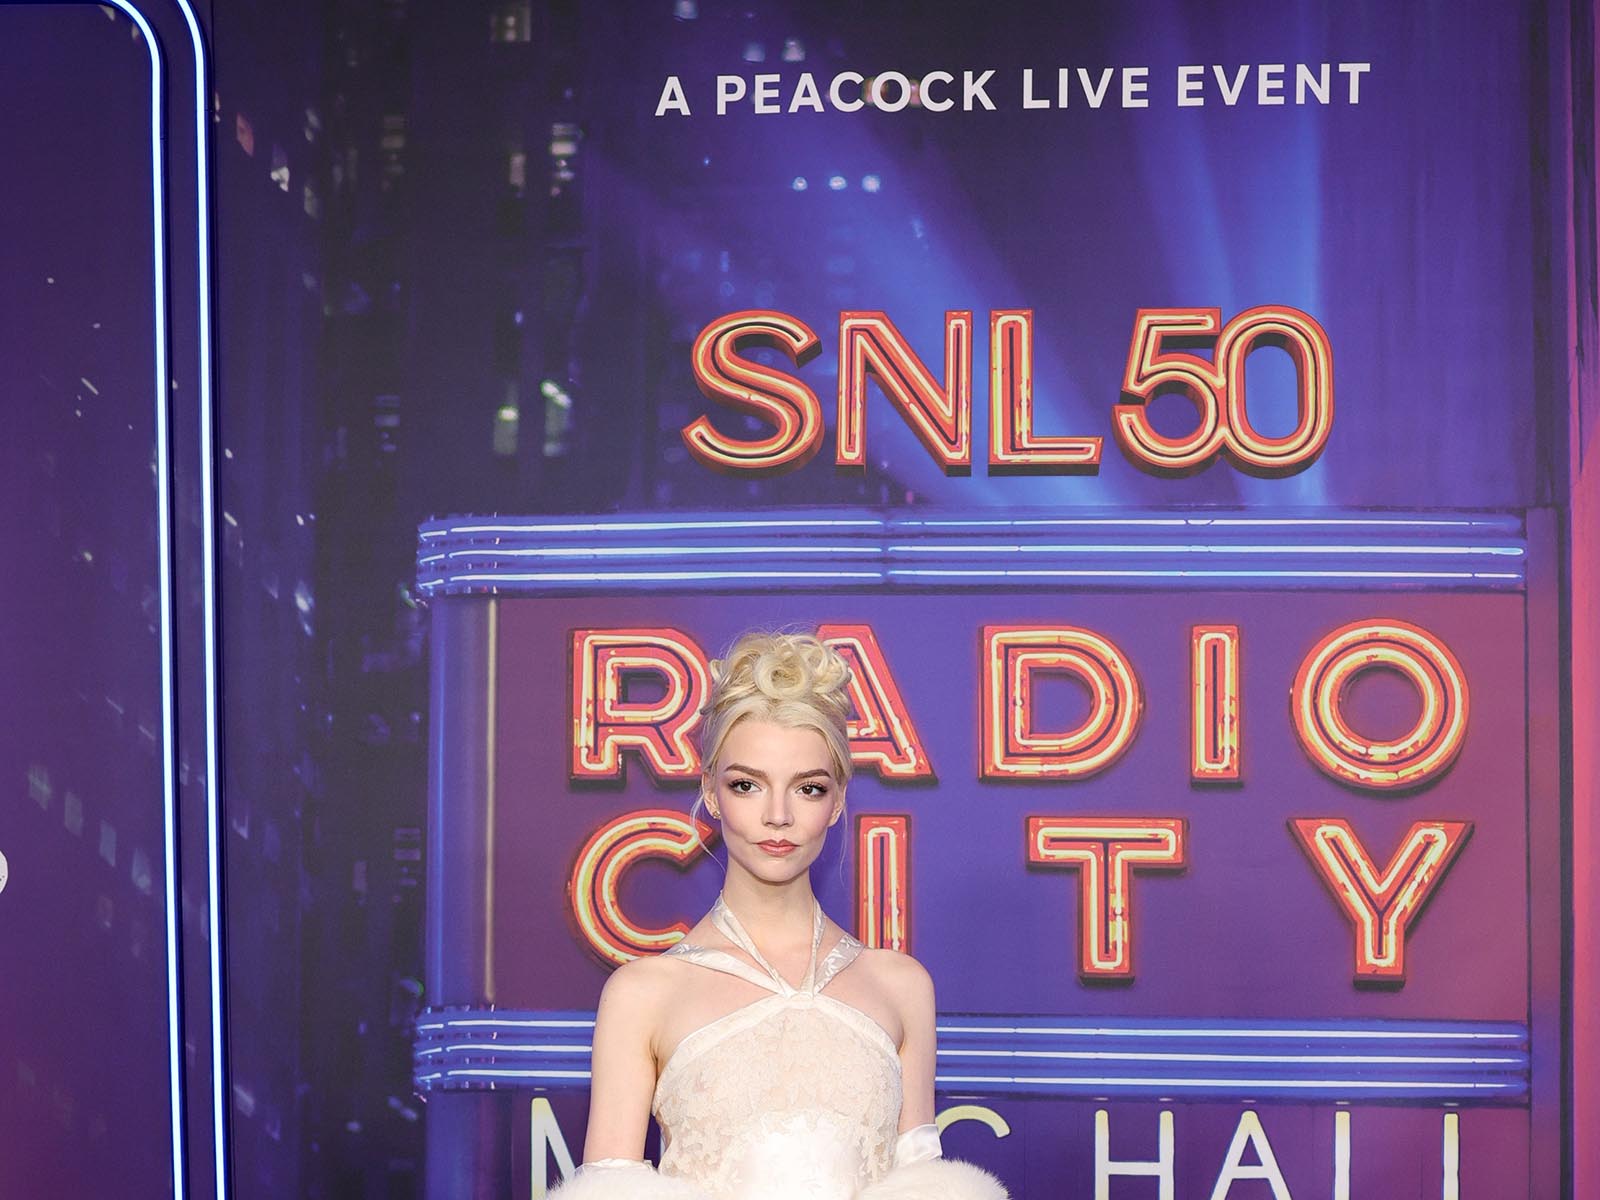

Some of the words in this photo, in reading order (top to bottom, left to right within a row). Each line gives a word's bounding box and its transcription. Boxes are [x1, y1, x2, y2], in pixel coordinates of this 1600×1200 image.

[655, 76, 691, 116] A
[716, 70, 997, 115] PEACOCK
[1023, 67, 1149, 109] LIVE
[1177, 63, 1371, 106] EVENT
[567, 809, 1474, 987] CITY
